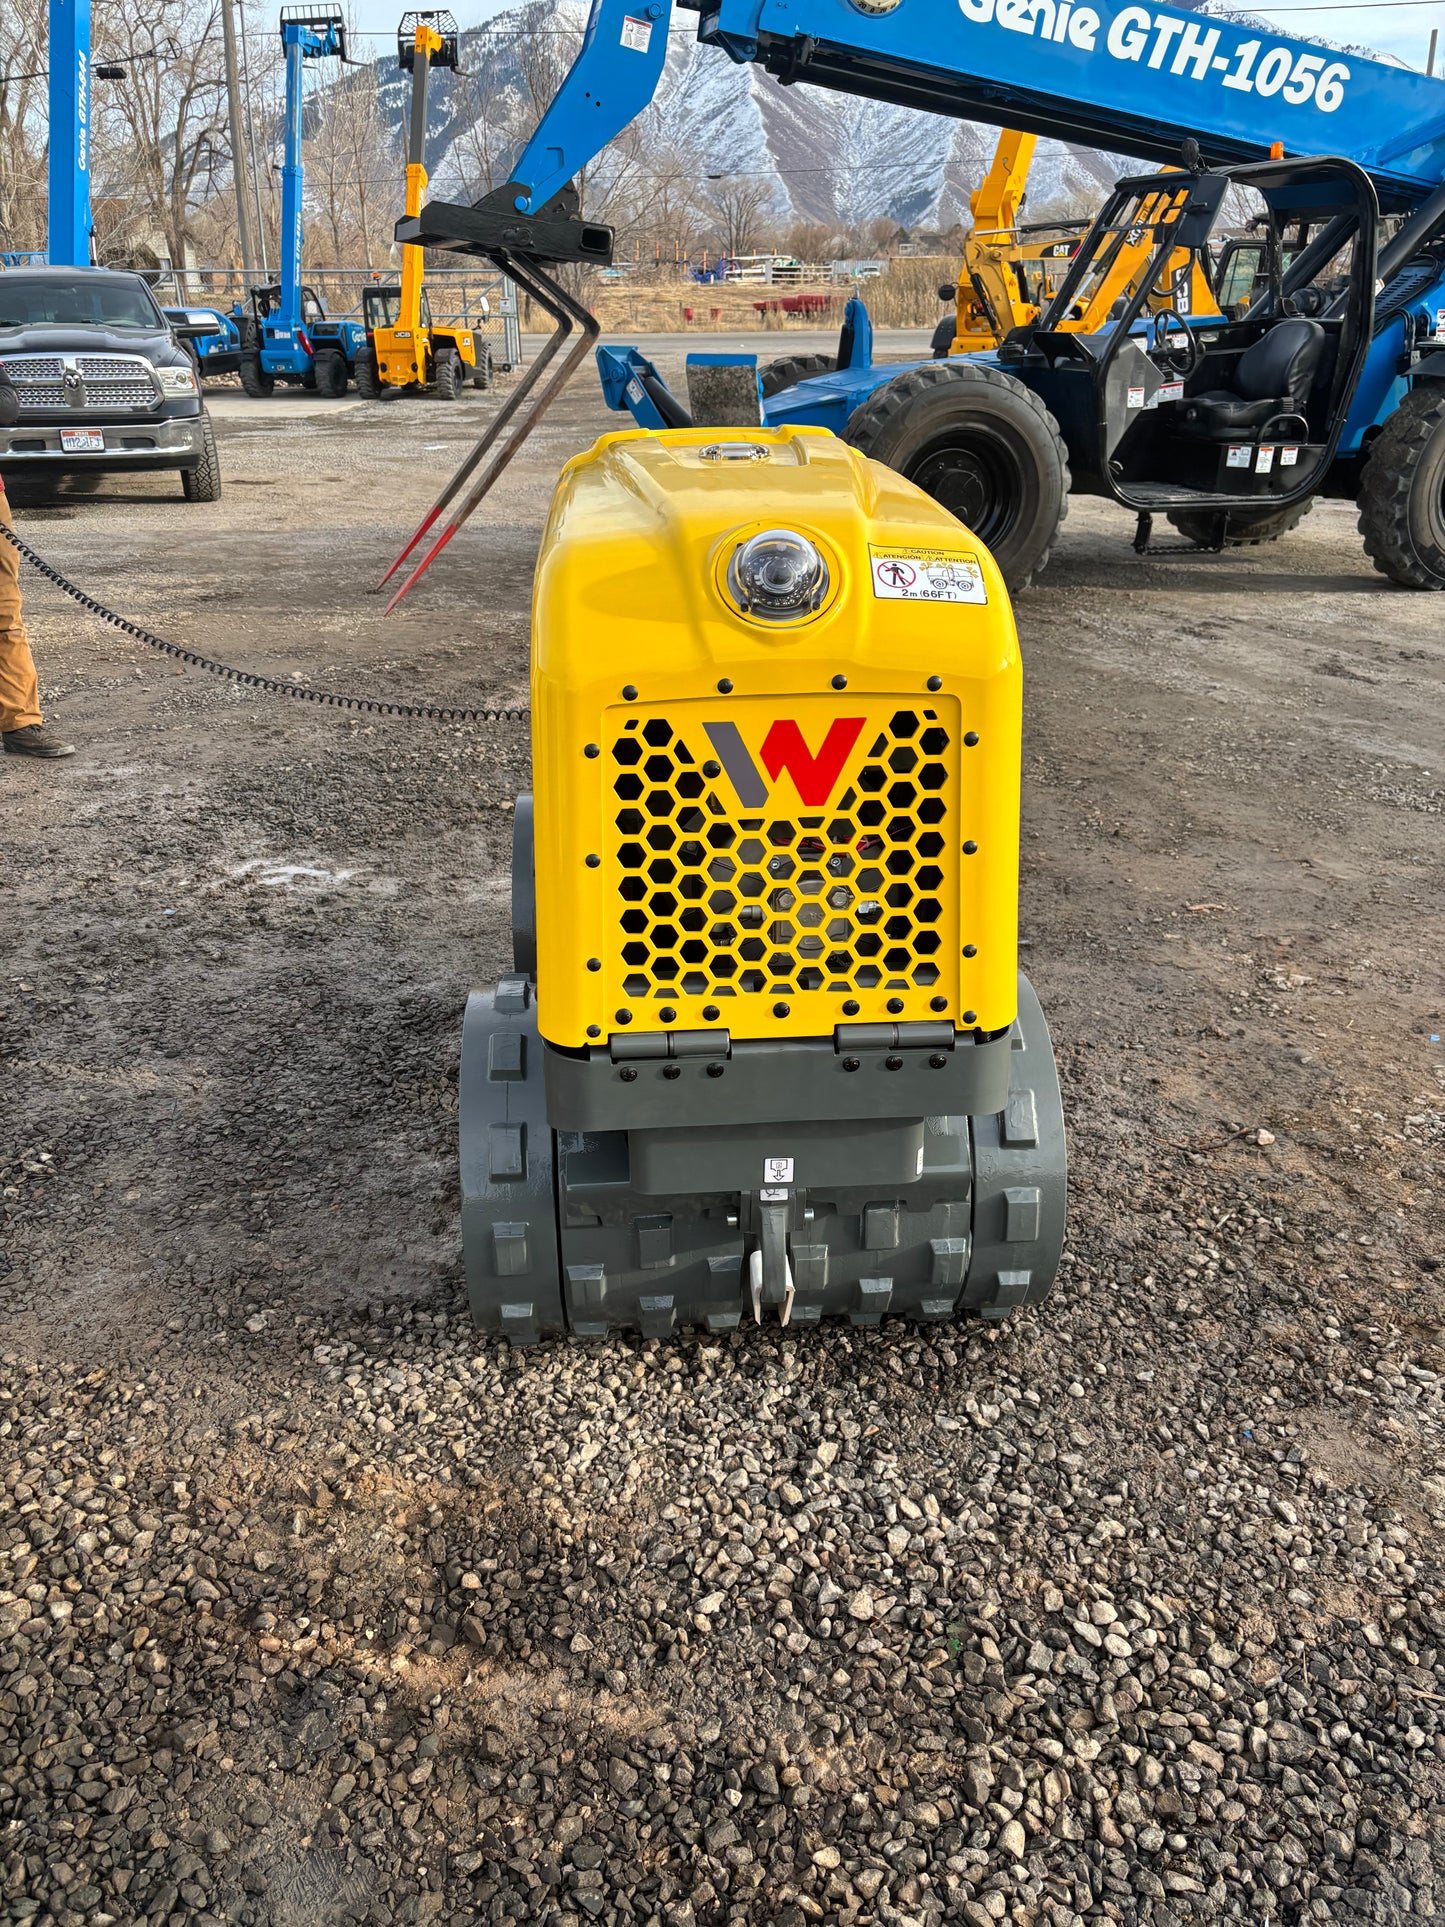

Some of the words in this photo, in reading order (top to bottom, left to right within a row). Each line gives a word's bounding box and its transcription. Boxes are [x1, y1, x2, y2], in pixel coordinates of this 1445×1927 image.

[78, 49, 87, 124] GTH-844
[1107, 6, 1351, 112] GTH-1056
[78, 127, 86, 171] Genie
[1053, 245, 1070, 257] CAT
